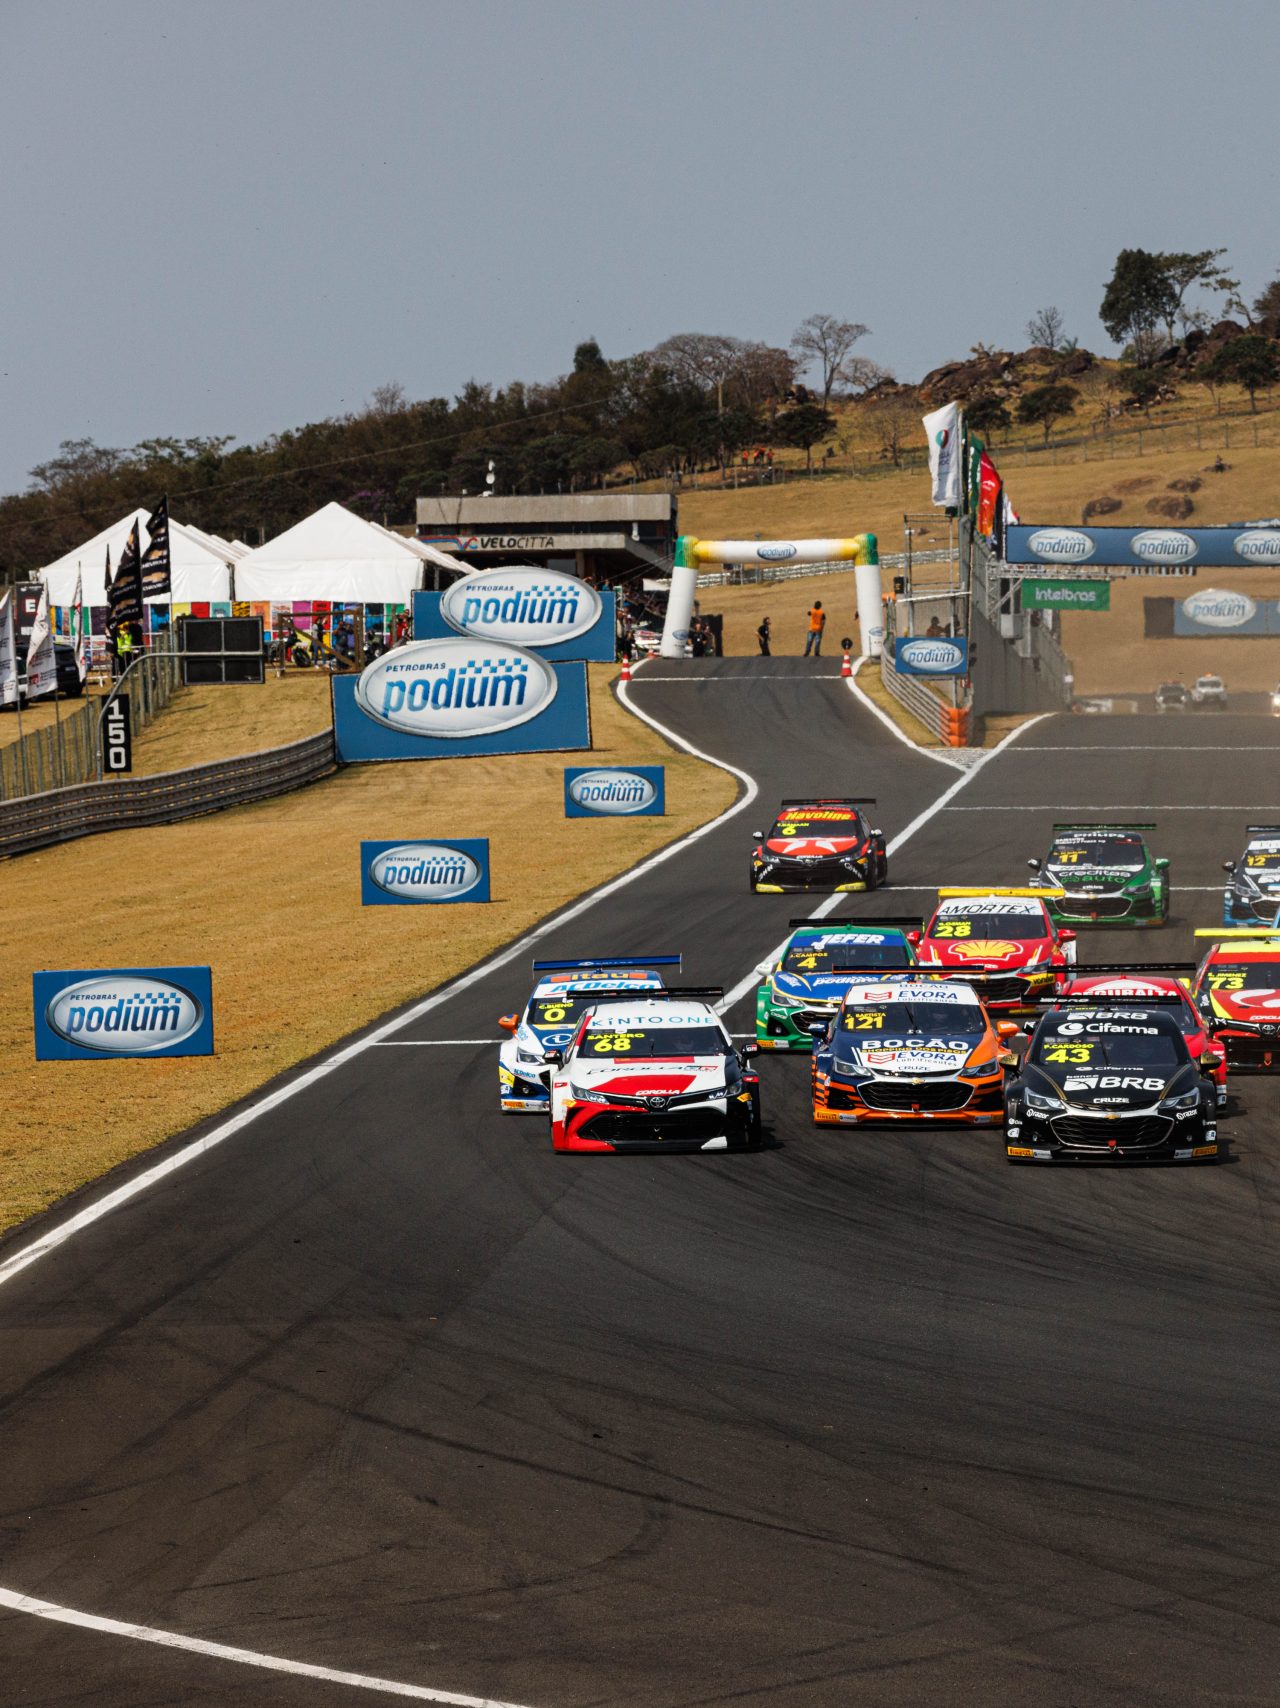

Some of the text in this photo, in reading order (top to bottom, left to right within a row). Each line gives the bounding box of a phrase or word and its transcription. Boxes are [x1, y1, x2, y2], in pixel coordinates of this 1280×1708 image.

[480, 537, 554, 549] VELOCITTA
[1035, 538, 1086, 555] podium
[1139, 539, 1189, 556] podium
[1035, 588, 1096, 602] intelbras
[460, 591, 579, 627] podium
[908, 650, 955, 664] podium
[386, 663, 446, 672] PETROBRAS
[382, 669, 527, 718] podium
[108, 698, 127, 769] 150
[579, 783, 645, 804] podium
[785, 811, 852, 821] Havoline
[782, 827, 796, 835] 6
[1059, 854, 1079, 863] 11
[1247, 857, 1266, 866] 12
[383, 861, 466, 888] podium
[941, 905, 1036, 914] AMORTEX
[935, 926, 971, 937] 28
[811, 934, 885, 949] JEFER
[797, 957, 817, 968] 4
[1209, 978, 1244, 989] 73
[899, 991, 958, 999] EVORA
[66, 999, 181, 1036] podium
[544, 1009, 566, 1022] 0
[1096, 1012, 1148, 1020] BRB
[845, 1017, 885, 1029] 121
[1086, 1023, 1158, 1035] Cifarma
[593, 1038, 631, 1052] 68
[862, 1039, 968, 1050] BOCÃO
[897, 1052, 957, 1062] EVORA
[1045, 1049, 1090, 1063] 43
[1099, 1077, 1165, 1091] BRB
